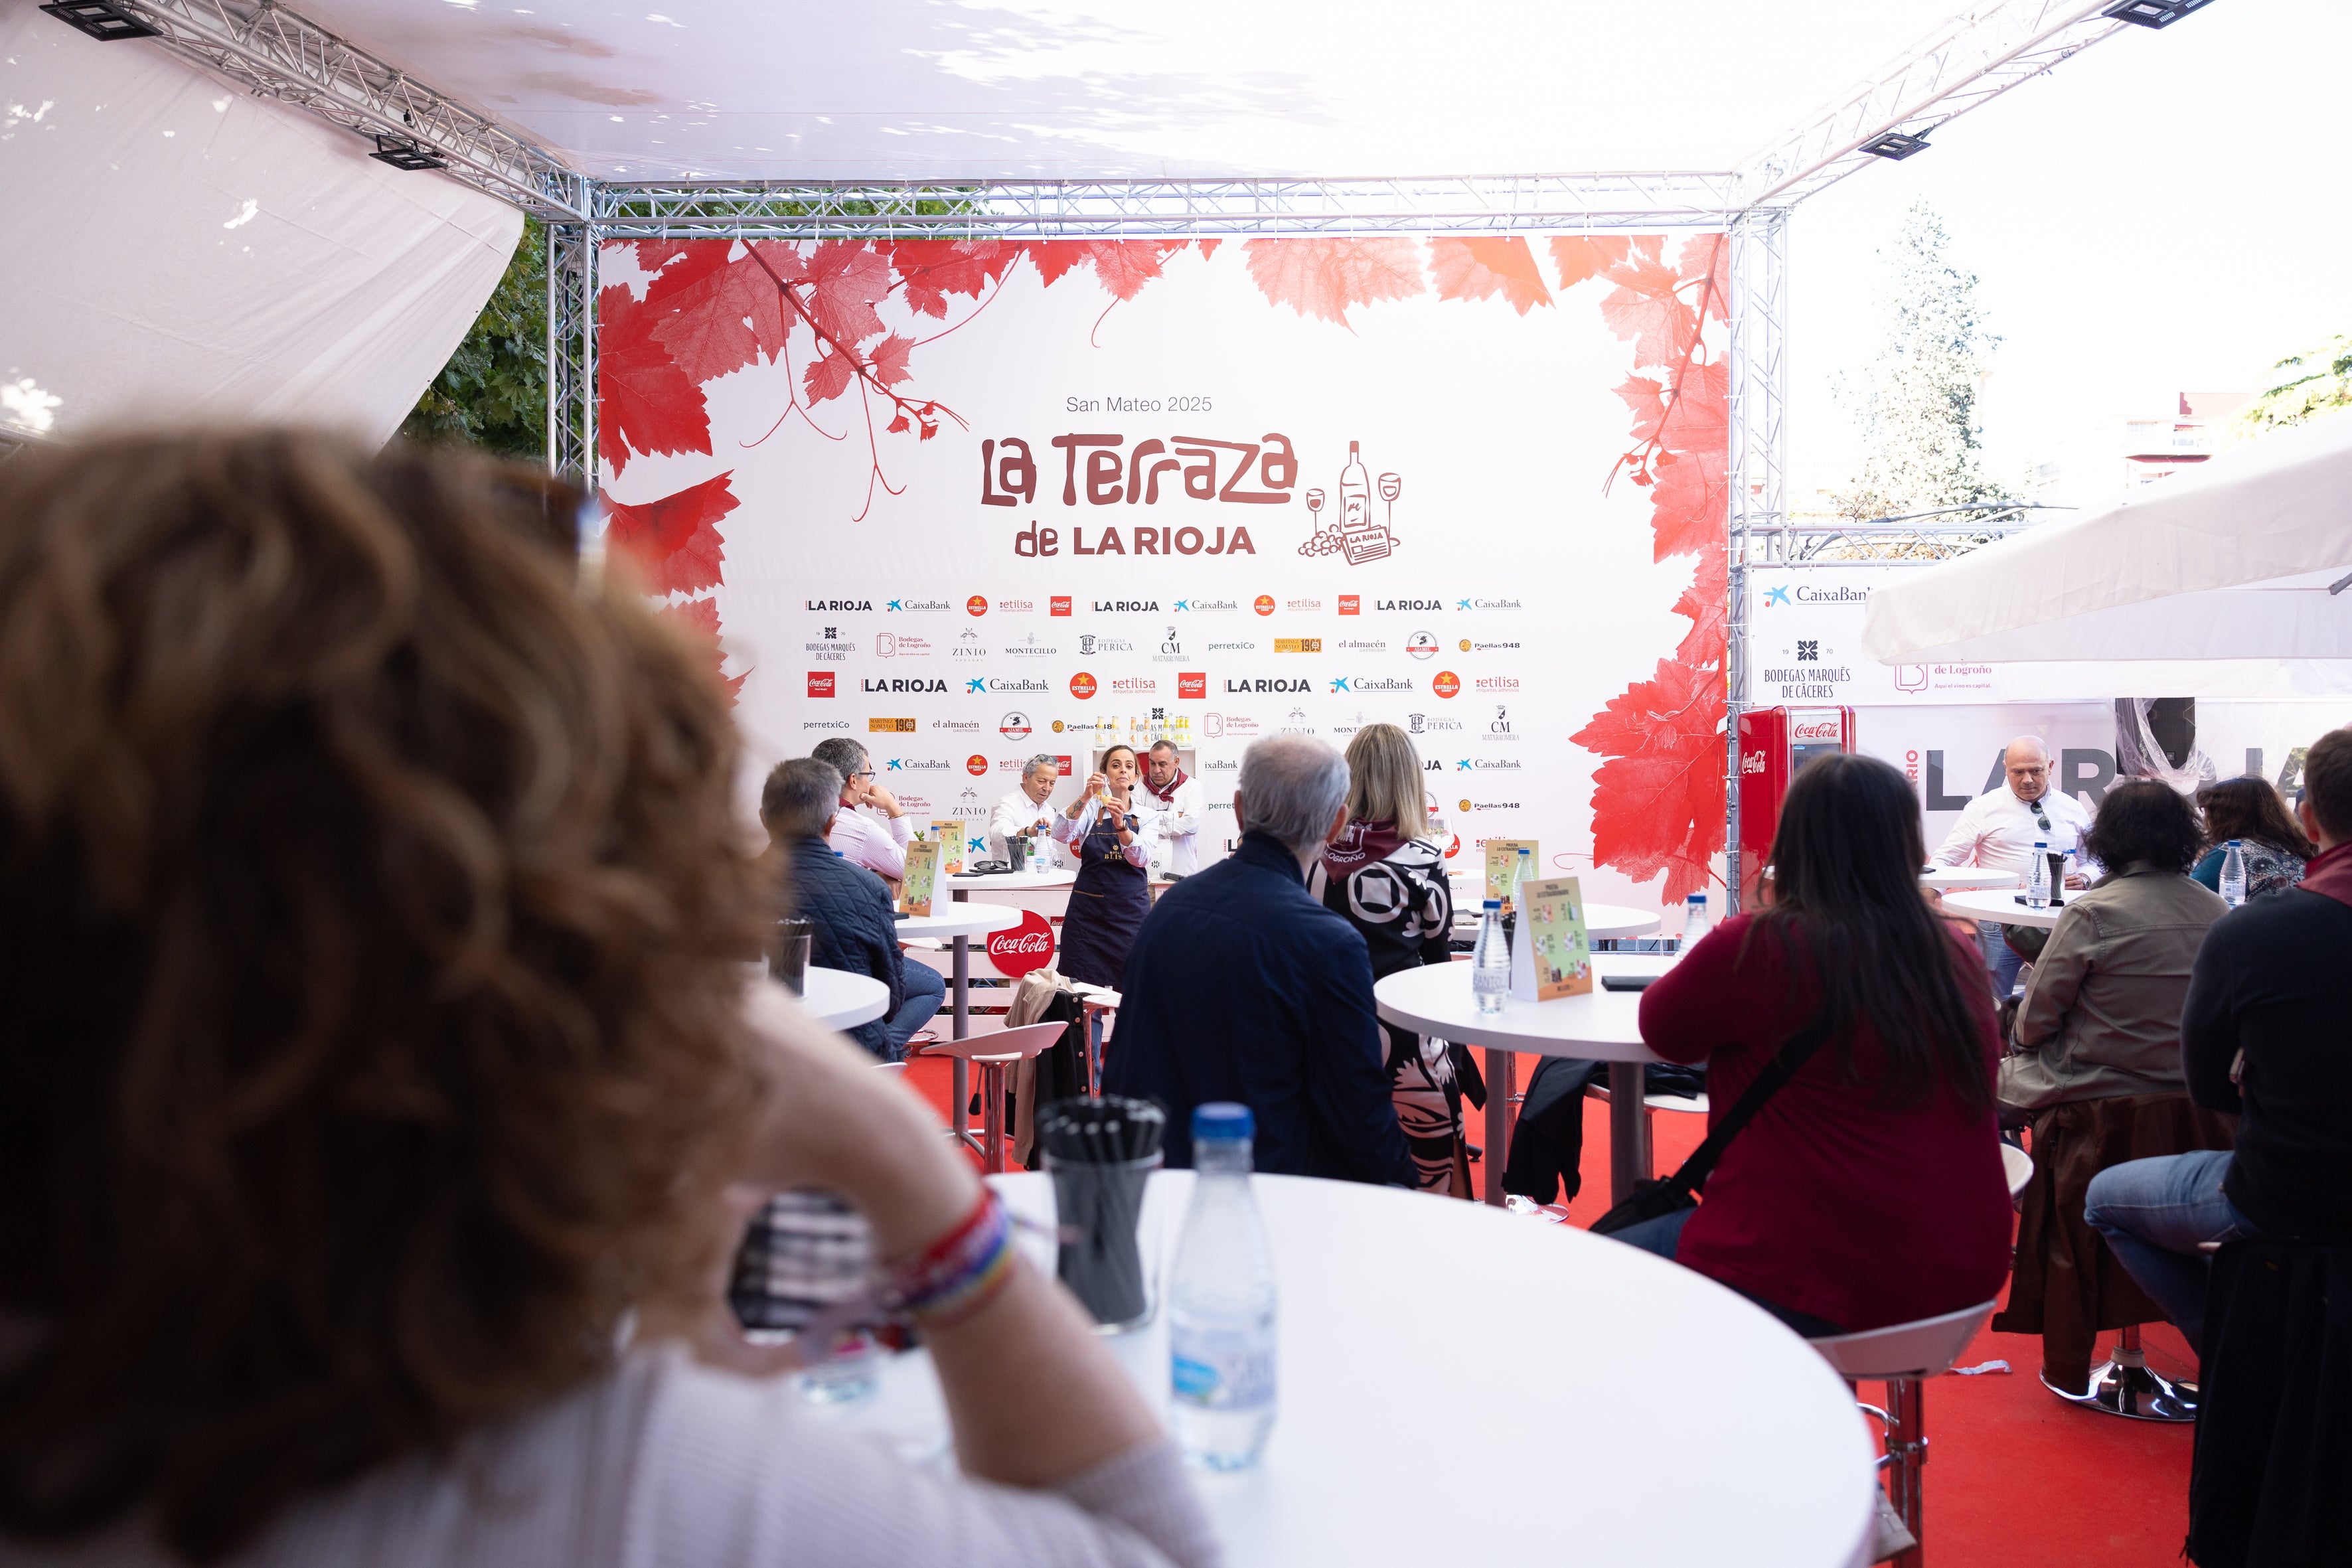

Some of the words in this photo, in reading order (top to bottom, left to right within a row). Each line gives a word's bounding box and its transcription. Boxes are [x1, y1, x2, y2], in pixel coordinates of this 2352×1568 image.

[1067, 397, 1099, 412] San
[1107, 397, 1161, 412] Mateo
[1168, 397, 1212, 412] 2025
[1052, 433, 1298, 506] Terraza
[1015, 520, 1058, 558] de
[1073, 526, 1126, 555] LA
[1135, 526, 1257, 555] RIOJA
[1362, 532, 1383, 541] RIOJA
[1797, 586, 1872, 601] CaixaBan
[809, 600, 826, 611] LA
[830, 600, 873, 611] RIOJA
[905, 600, 951, 609] CaixaBank
[1003, 599, 1033, 608] etilisa
[1095, 601, 1113, 611] LA
[1117, 601, 1159, 611] RIOJA
[1192, 600, 1237, 609] CaixaBank
[1291, 599, 1321, 607] etilisa
[1377, 600, 1395, 611] LA
[1399, 600, 1442, 611] RIOJA
[1475, 599, 1522, 608] CaixaBank
[1161, 643, 1180, 654] CM
[1208, 642, 1255, 651] perretxiCo
[1764, 669, 1805, 682] BODEGAS
[1934, 665, 1946, 674] de
[1950, 665, 1992, 676] Logroño
[865, 679, 889, 692] LA
[892, 679, 948, 692] RIOJA
[990, 678, 1049, 690] CaixaBank
[1117, 678, 1156, 688] etilisa
[1228, 679, 1252, 692] LA
[1255, 679, 1311, 692] RIOJA
[1354, 678, 1413, 690] CaixaBank
[1480, 676, 1520, 688] etilisa
[1782, 685, 1793, 698] DE
[803, 721, 850, 730] perretxiCo
[1491, 722, 1510, 733] CM
[1794, 722, 1839, 738] Coca-Cola
[905, 759, 951, 769] CaixaBank
[1205, 760, 1237, 769] ixaBank
[1475, 759, 1522, 769] CaixaBank
[1742, 750, 1766, 774] Coca-Cola
[1324, 850, 1366, 863] LOGROÑO
[990, 931, 1051, 955] Coca-Cola
